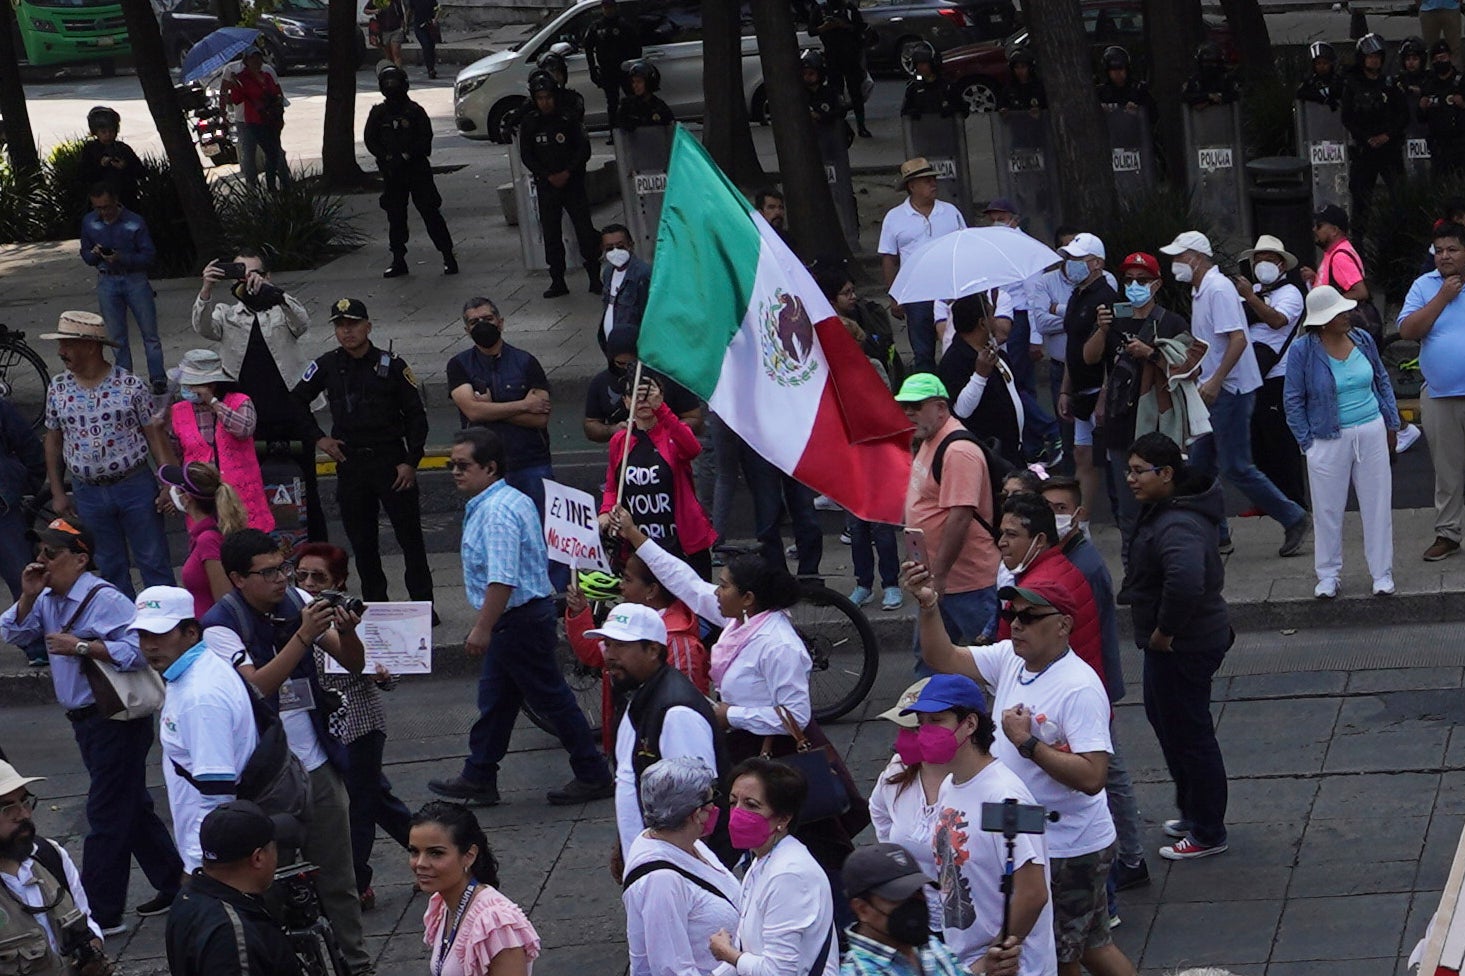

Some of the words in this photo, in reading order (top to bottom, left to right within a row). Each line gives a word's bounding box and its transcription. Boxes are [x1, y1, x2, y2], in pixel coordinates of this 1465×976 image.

[1312, 146, 1343, 163] POLICIA
[1410, 141, 1430, 157] POLI
[1114, 152, 1139, 169] OLICIA
[1200, 150, 1231, 167] POLICIA
[625, 465, 660, 486] RIDE
[626, 492, 671, 515] YOUR
[550, 496, 562, 519] EL
[565, 498, 594, 531] INE
[638, 523, 678, 539] ORL
[547, 527, 560, 550] NO
[570, 536, 604, 569] TOCA!
